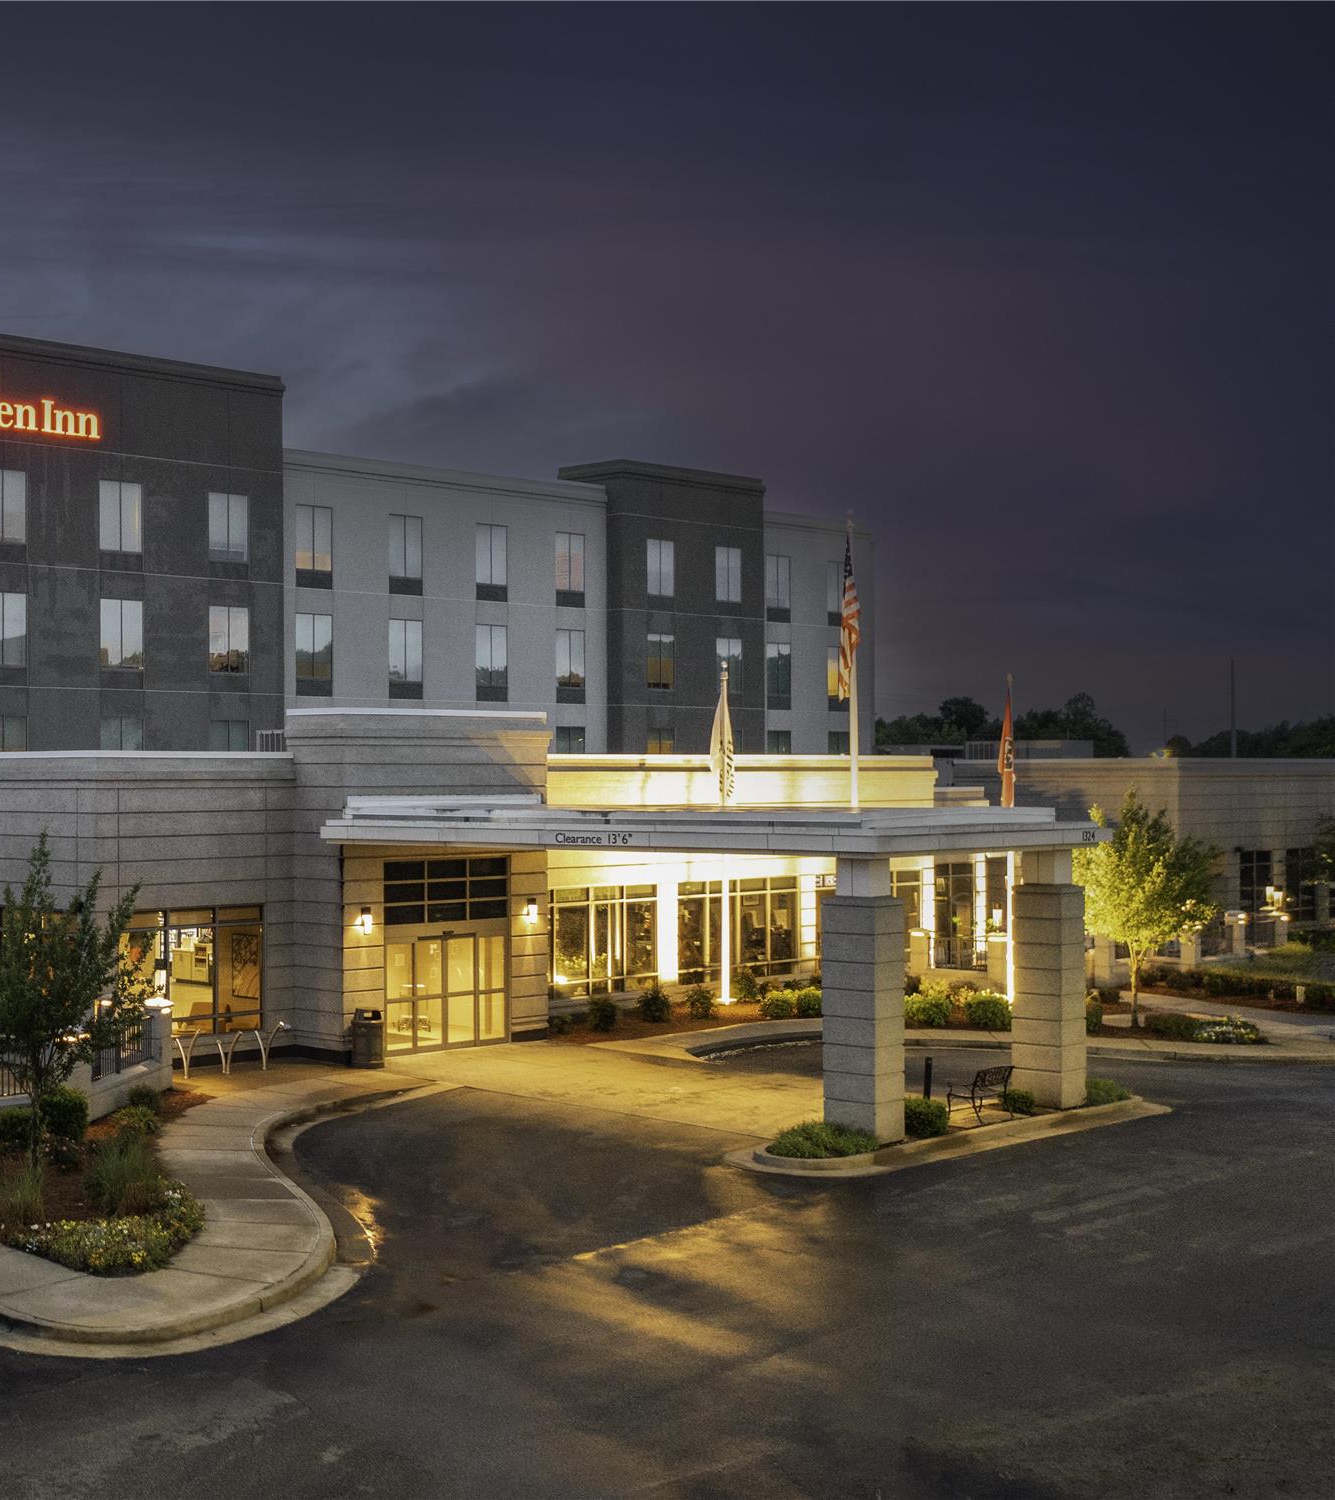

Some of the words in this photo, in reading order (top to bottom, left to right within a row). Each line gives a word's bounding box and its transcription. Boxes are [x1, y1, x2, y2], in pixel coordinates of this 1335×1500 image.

[41, 399, 101, 440] Inn
[555, 832, 602, 845] Clearance
[607, 833, 633, 845] 13'6"
